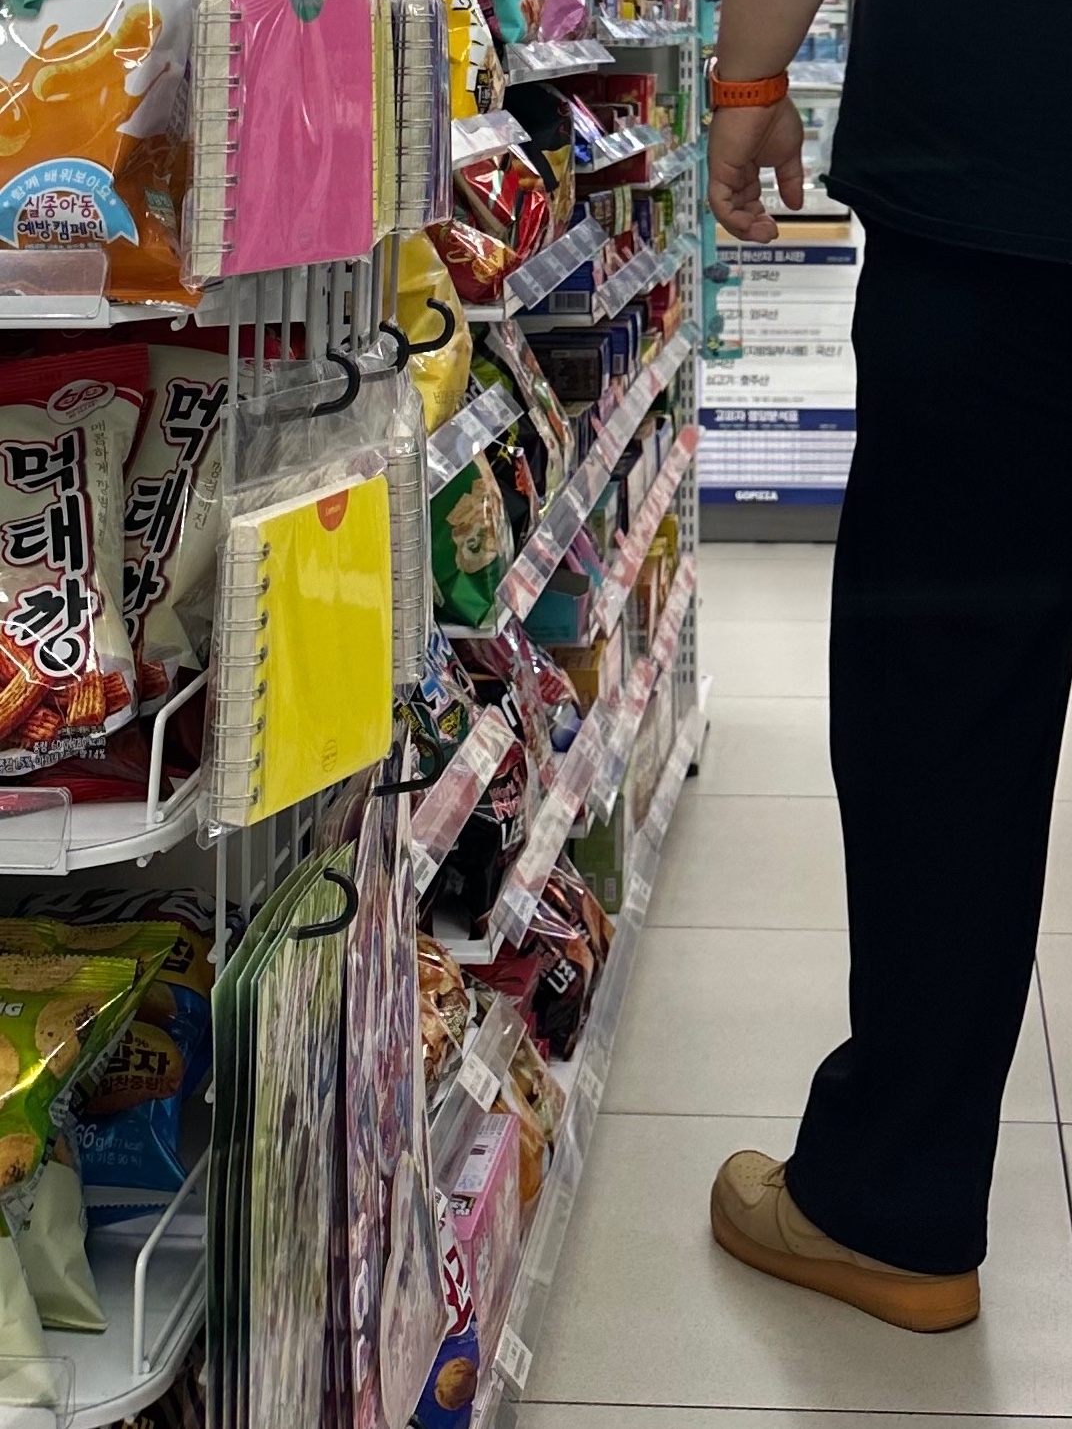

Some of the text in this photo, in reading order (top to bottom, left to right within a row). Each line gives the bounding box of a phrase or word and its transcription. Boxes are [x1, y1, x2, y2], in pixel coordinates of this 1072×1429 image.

[25, 194, 95, 219] 실종아동
[17, 220, 105, 240] 예방캠페인
[4, 432, 93, 672] 먹태깡
